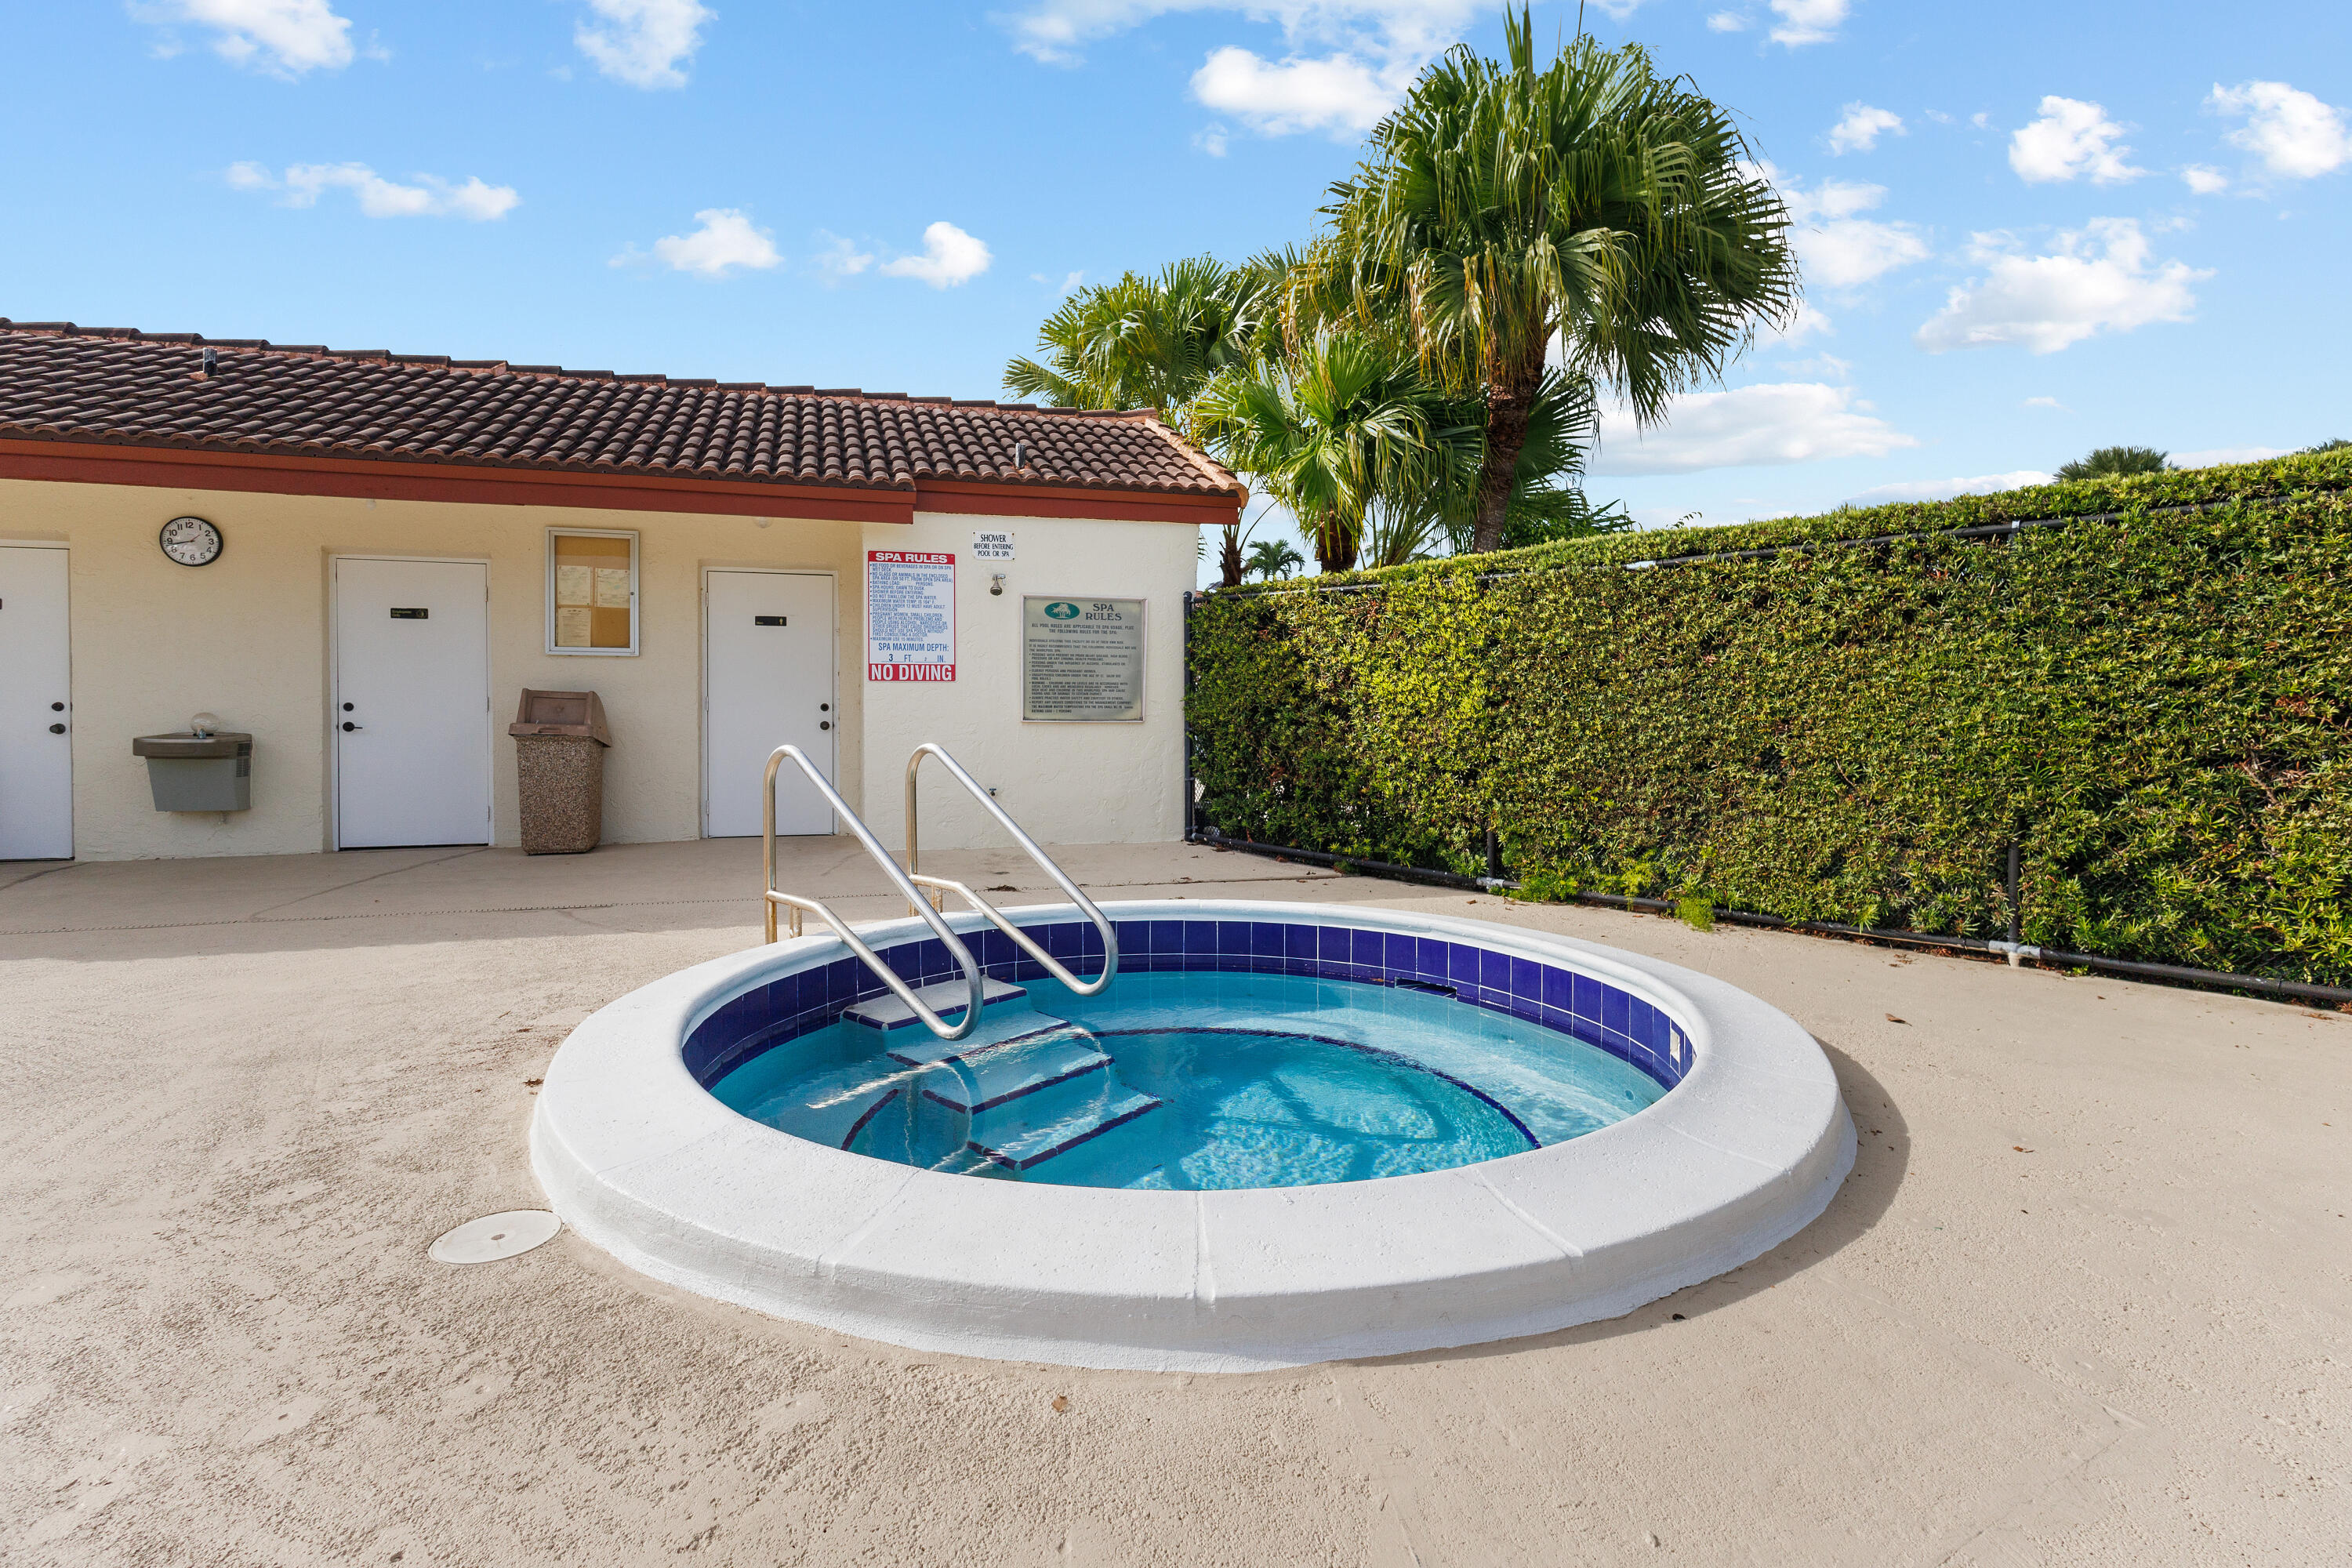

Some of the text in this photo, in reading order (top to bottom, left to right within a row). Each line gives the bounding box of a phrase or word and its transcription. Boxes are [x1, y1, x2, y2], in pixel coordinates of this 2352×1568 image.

[876, 553, 947, 564] SPA RULES
[1086, 612, 1122, 621] RULES
[893, 643, 924, 652] MAXIMUM
[872, 665, 952, 681] NO DIVING
